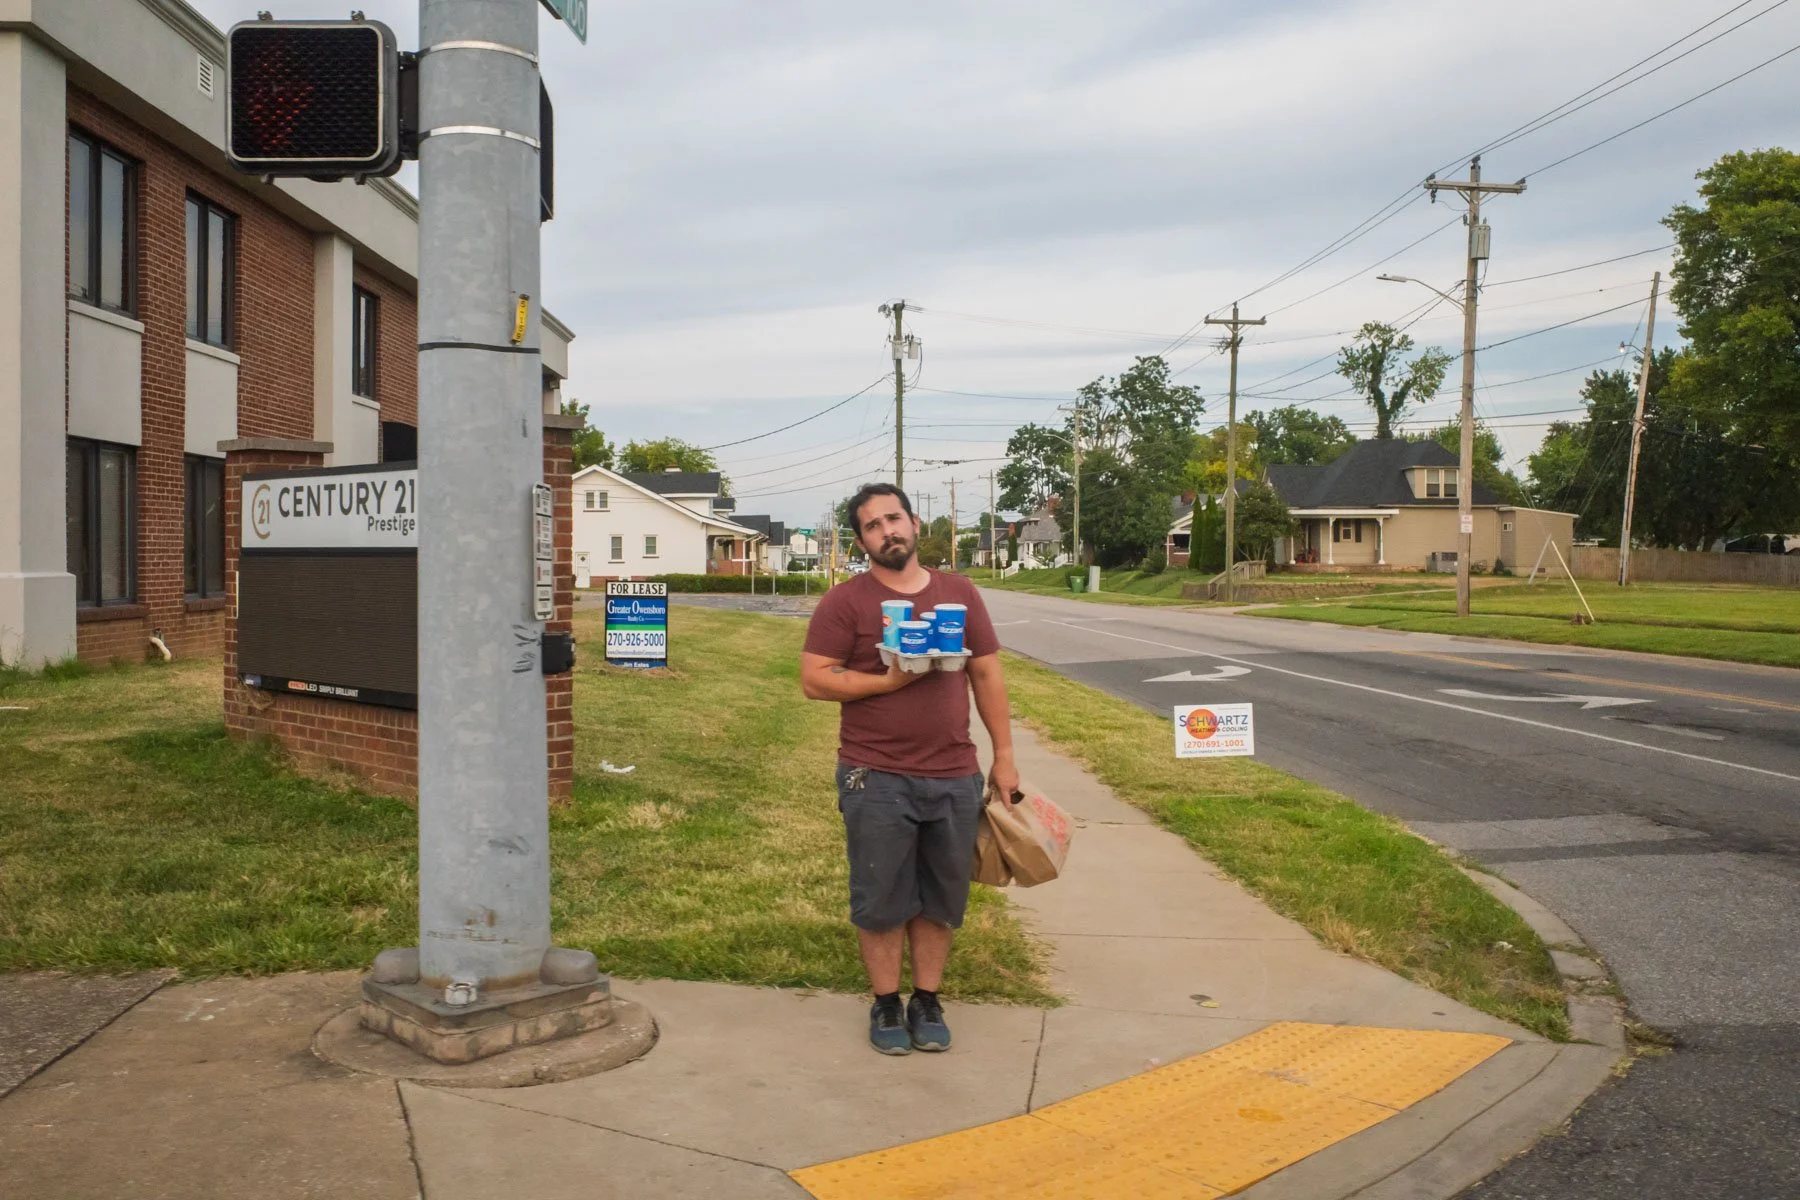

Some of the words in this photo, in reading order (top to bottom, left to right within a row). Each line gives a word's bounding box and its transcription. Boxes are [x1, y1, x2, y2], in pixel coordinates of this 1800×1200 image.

[278, 480, 388, 518] CENTURY
[395, 478, 416, 514] 21
[367, 515, 416, 536] Prestige
[610, 583, 629, 594] FOR
[632, 583, 664, 595] LEASE
[607, 599, 631, 615] Greater
[632, 600, 666, 615] Owensboro
[607, 632, 665, 646] 270-926-5000
[1179, 715, 1248, 727] SCHWARTZ
